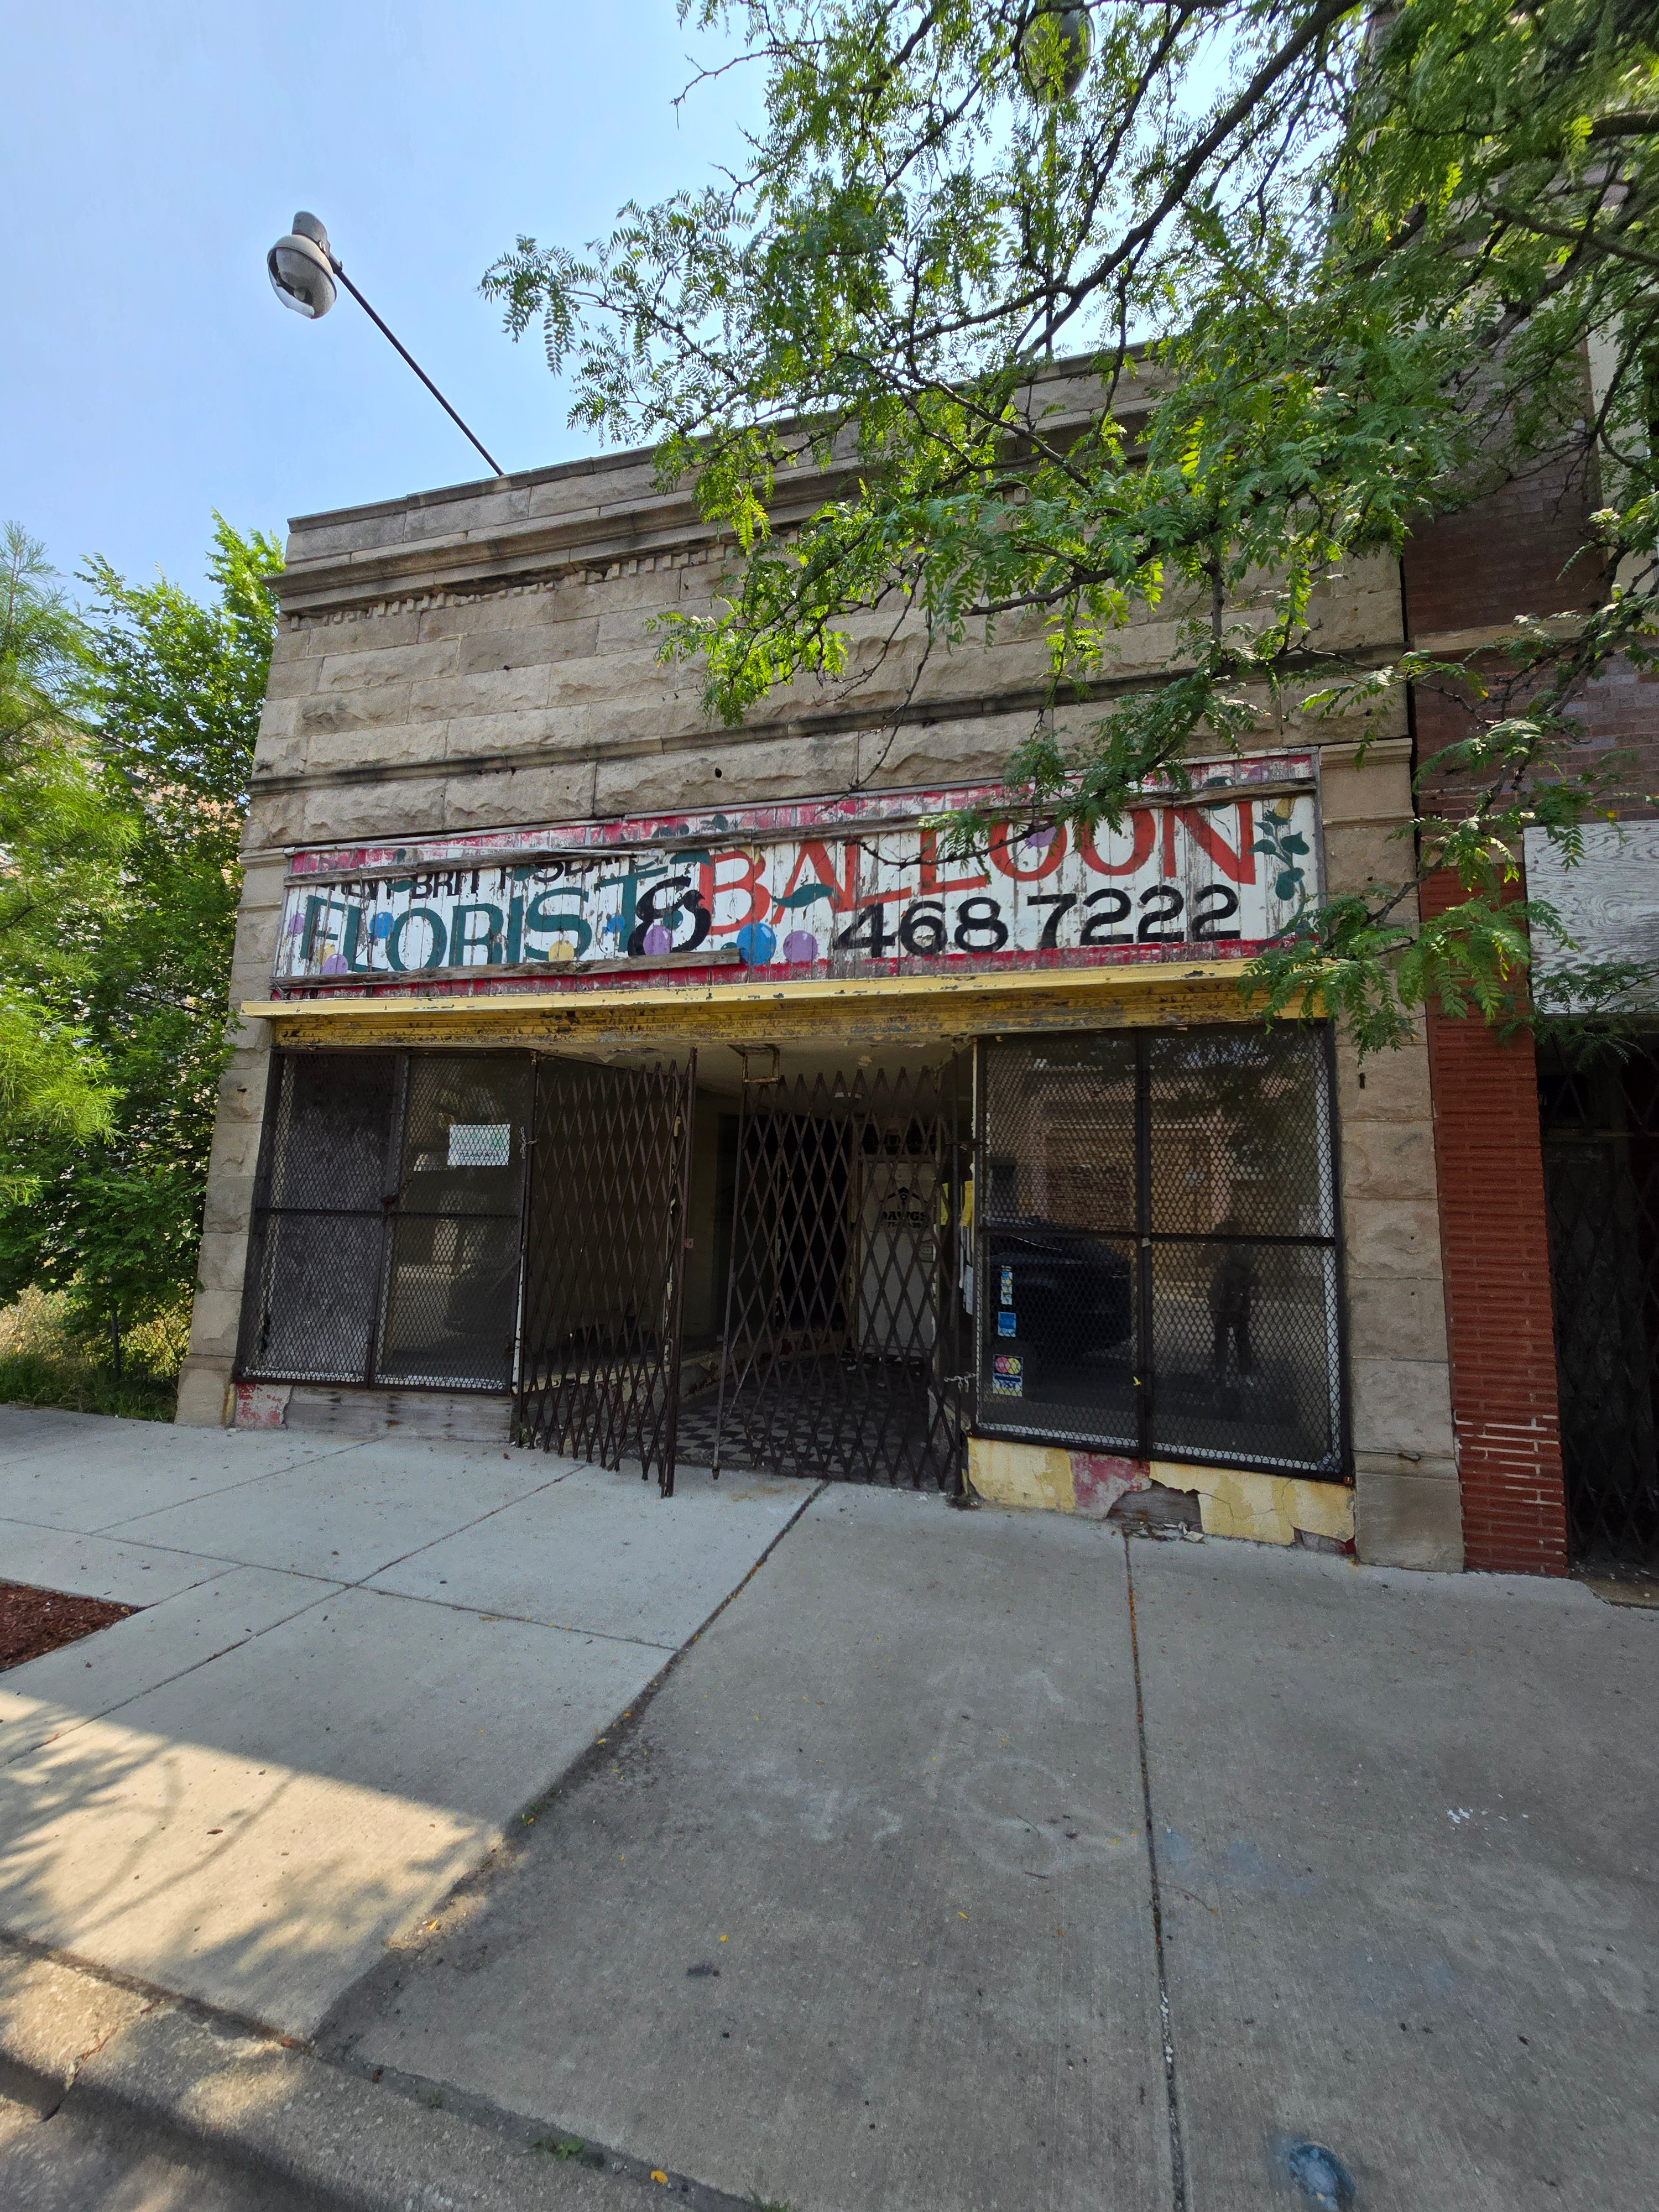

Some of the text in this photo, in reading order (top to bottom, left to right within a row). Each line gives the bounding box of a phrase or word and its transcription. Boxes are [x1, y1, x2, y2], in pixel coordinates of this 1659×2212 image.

[300, 800, 1256, 972] FLORIST & BALLOON
[833, 884, 1241, 958] 468 7222
